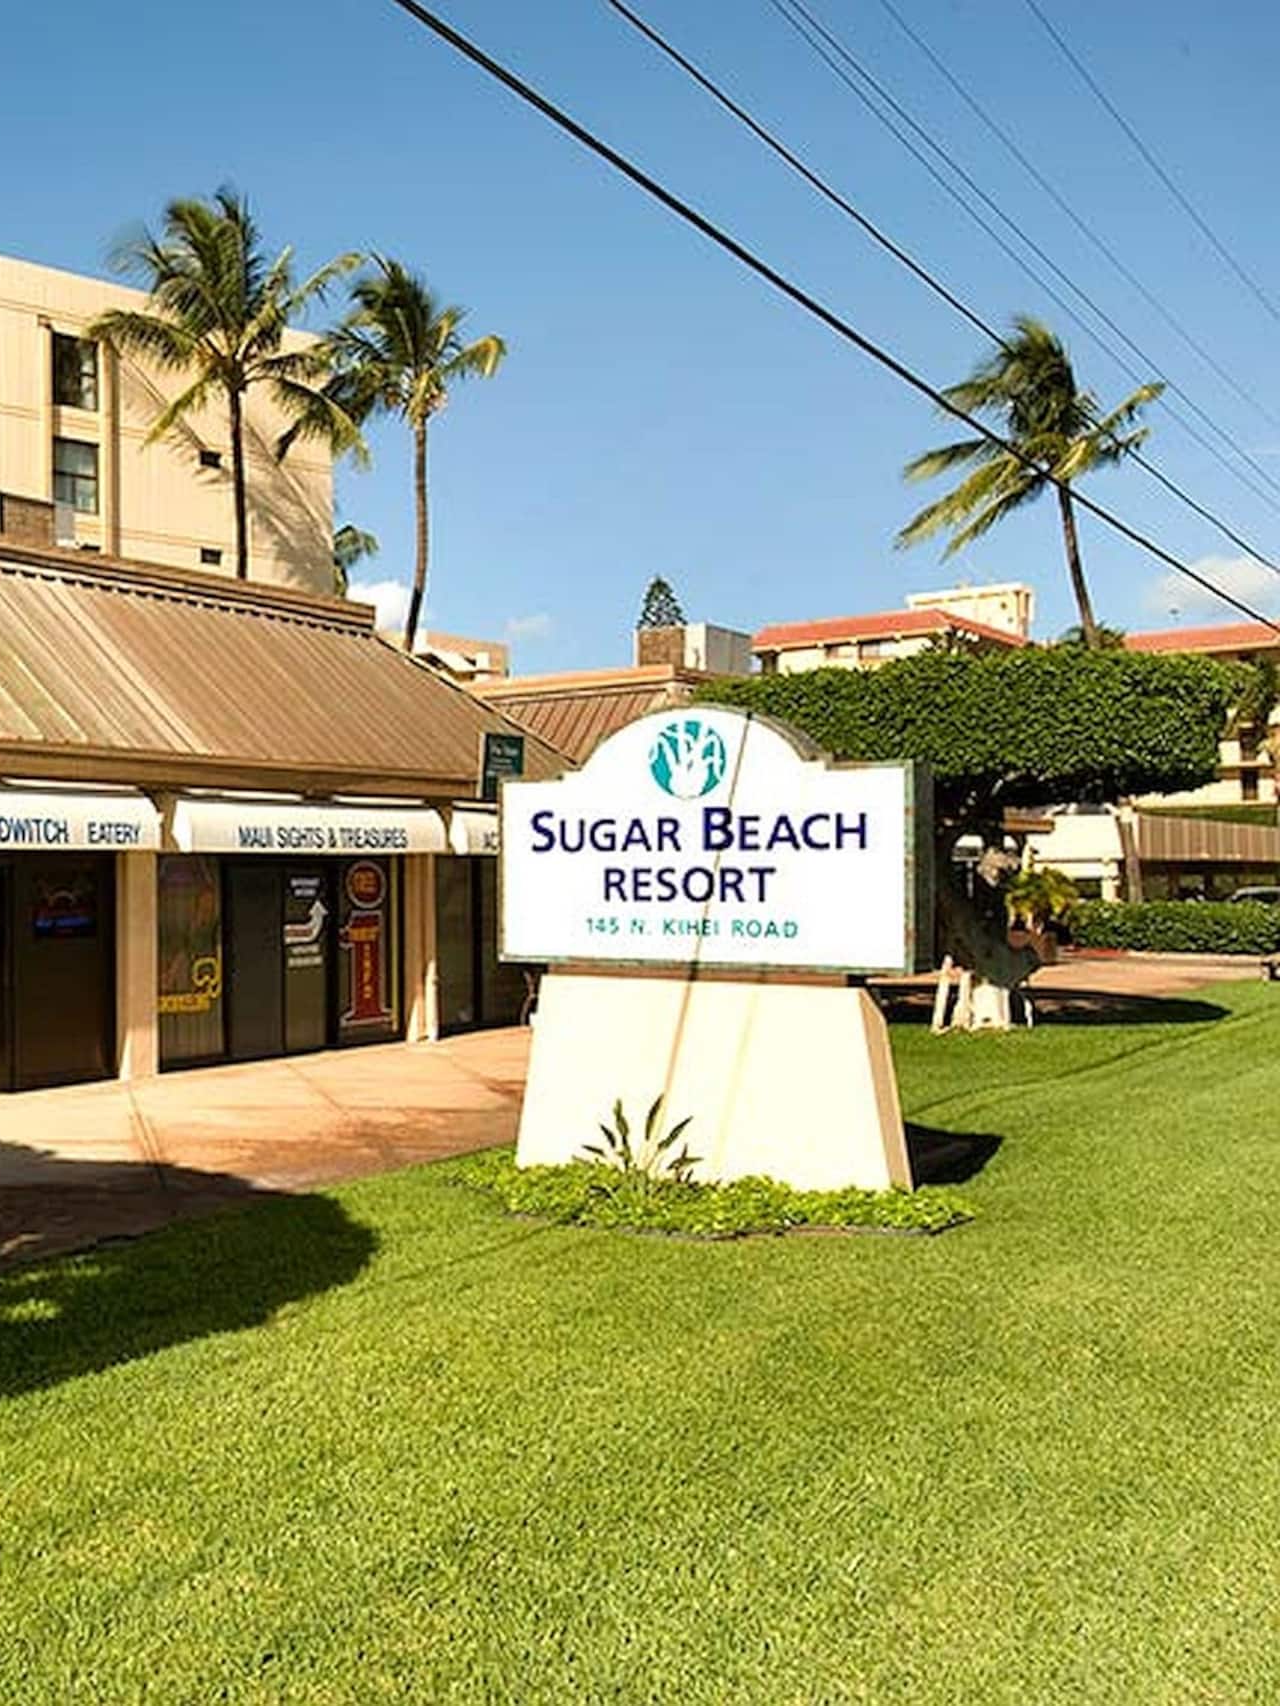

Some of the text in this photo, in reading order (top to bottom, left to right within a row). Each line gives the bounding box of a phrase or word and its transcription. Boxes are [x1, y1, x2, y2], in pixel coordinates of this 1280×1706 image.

[87, 822, 141, 844] EATERY
[239, 826, 408, 848] MAUI SIGHTS & TREASURES
[531, 807, 867, 853] SUGAR BEACH
[604, 867, 776, 902] RESORT
[586, 918, 620, 935] 145
[663, 918, 720, 937] KIHEI
[731, 919, 798, 938] ROAD
